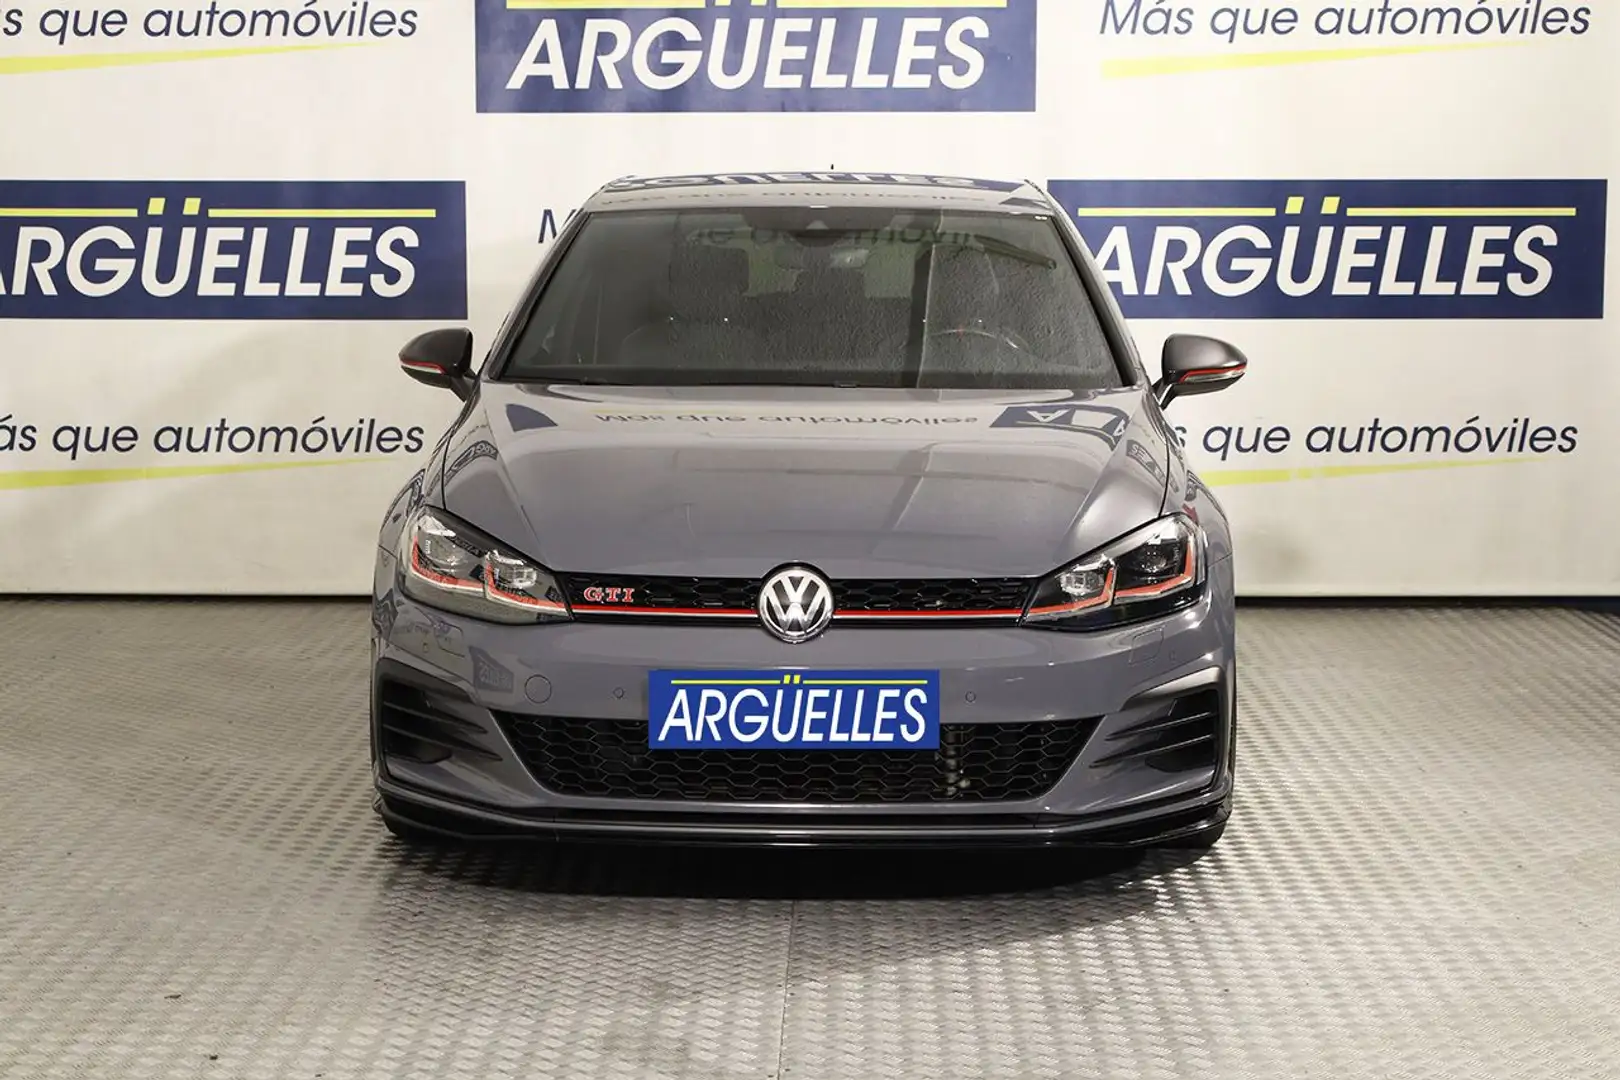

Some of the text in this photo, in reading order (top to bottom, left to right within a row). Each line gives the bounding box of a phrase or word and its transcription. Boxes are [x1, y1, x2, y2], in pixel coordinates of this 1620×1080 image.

[40, 10, 127, 45] que
[144, 0, 417, 36] automóviles
[1211, 8, 1298, 43] que
[1315, 0, 1591, 35] automóviles
[0, 198, 419, 297] RGÜELLES
[1094, 197, 1558, 297] ARGÜELLES
[53, 426, 138, 460] que
[154, 415, 424, 453] automóviles
[1203, 426, 1290, 461] que
[1306, 416, 1577, 453] automóviles
[584, 586, 635, 603] GTI
[658, 675, 928, 742] ARGÜELLES
